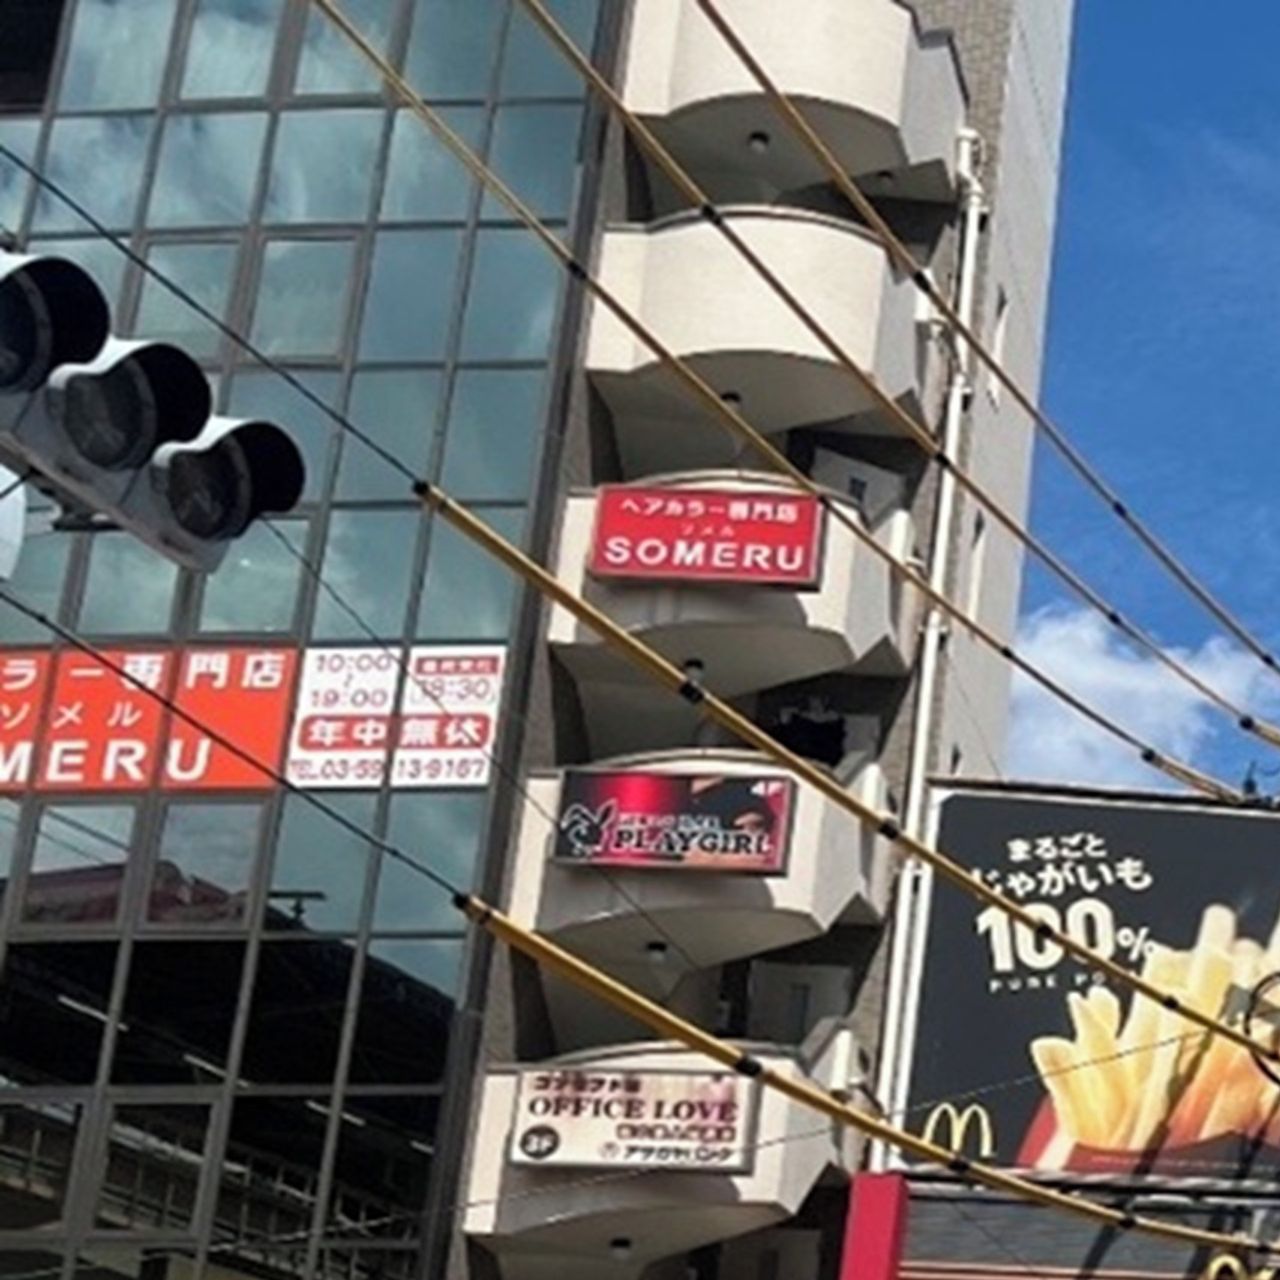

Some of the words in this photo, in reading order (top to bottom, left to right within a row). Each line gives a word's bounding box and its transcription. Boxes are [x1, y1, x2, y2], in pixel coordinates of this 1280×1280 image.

[604, 536, 803, 571] SOMERU
[317, 654, 391, 673] 10:00
[312, 689, 388, 708] 19:00
[308, 719, 484, 747] 年中無休
[613, 828, 771, 854] PLAYGIRL
[1007, 832, 1107, 862] まるごと
[976, 897, 1158, 972] 100%
[528, 1096, 646, 1119] OFFICE
[653, 1099, 738, 1122] LOVE
